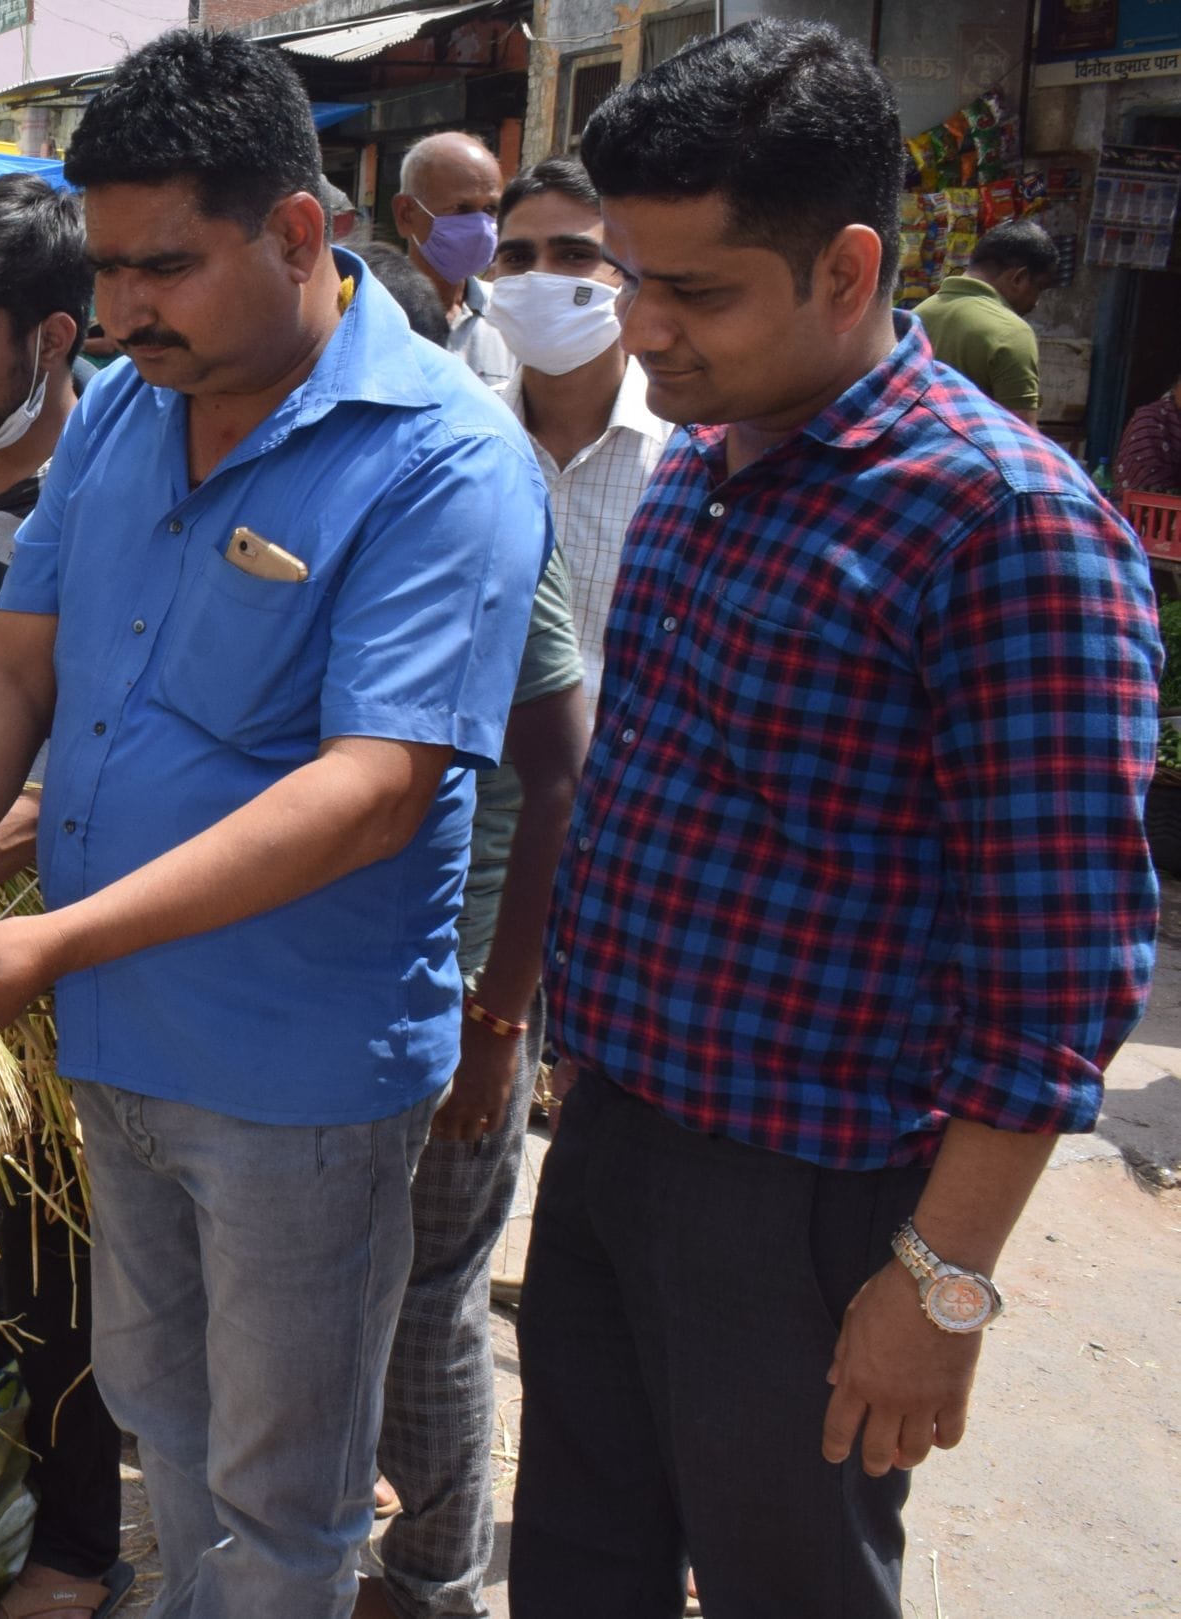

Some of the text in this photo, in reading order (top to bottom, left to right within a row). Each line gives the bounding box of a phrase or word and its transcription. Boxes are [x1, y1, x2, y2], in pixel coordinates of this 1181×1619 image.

[1075, 54, 1179, 80] विनोद कुमार पान
